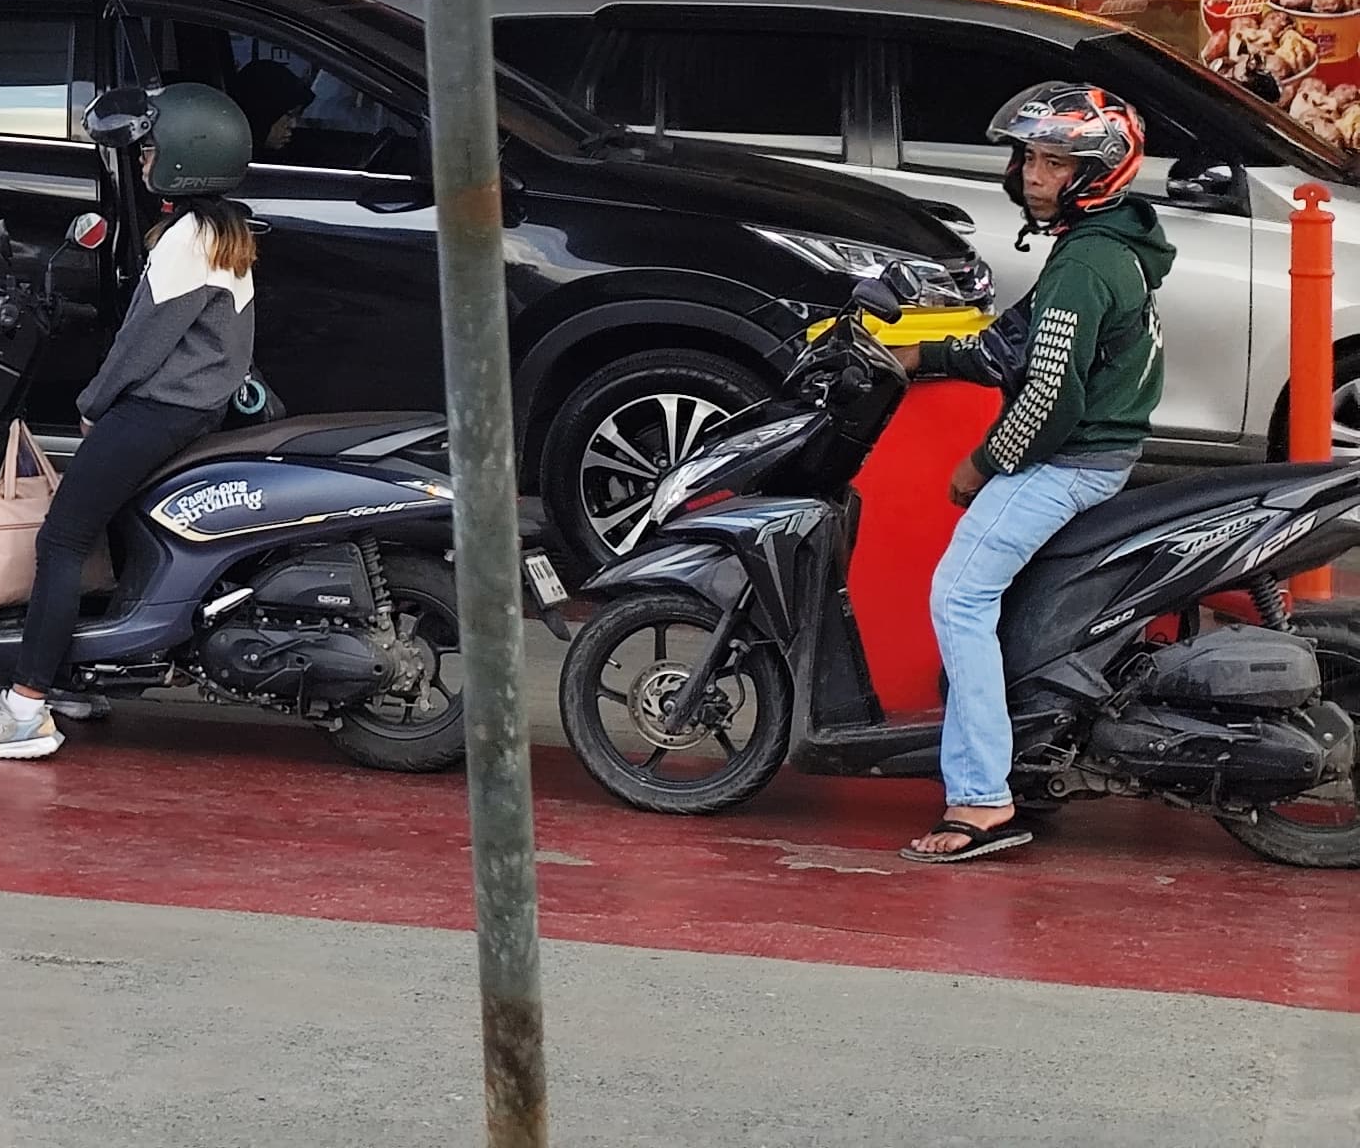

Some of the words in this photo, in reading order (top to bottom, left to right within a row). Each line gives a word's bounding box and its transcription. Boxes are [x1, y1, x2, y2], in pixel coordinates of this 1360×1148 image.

[172, 488, 264, 530] Strolling
[176, 479, 249, 513] FABULOUS
[347, 502, 406, 518] Genio
[1241, 509, 1320, 574] 125
